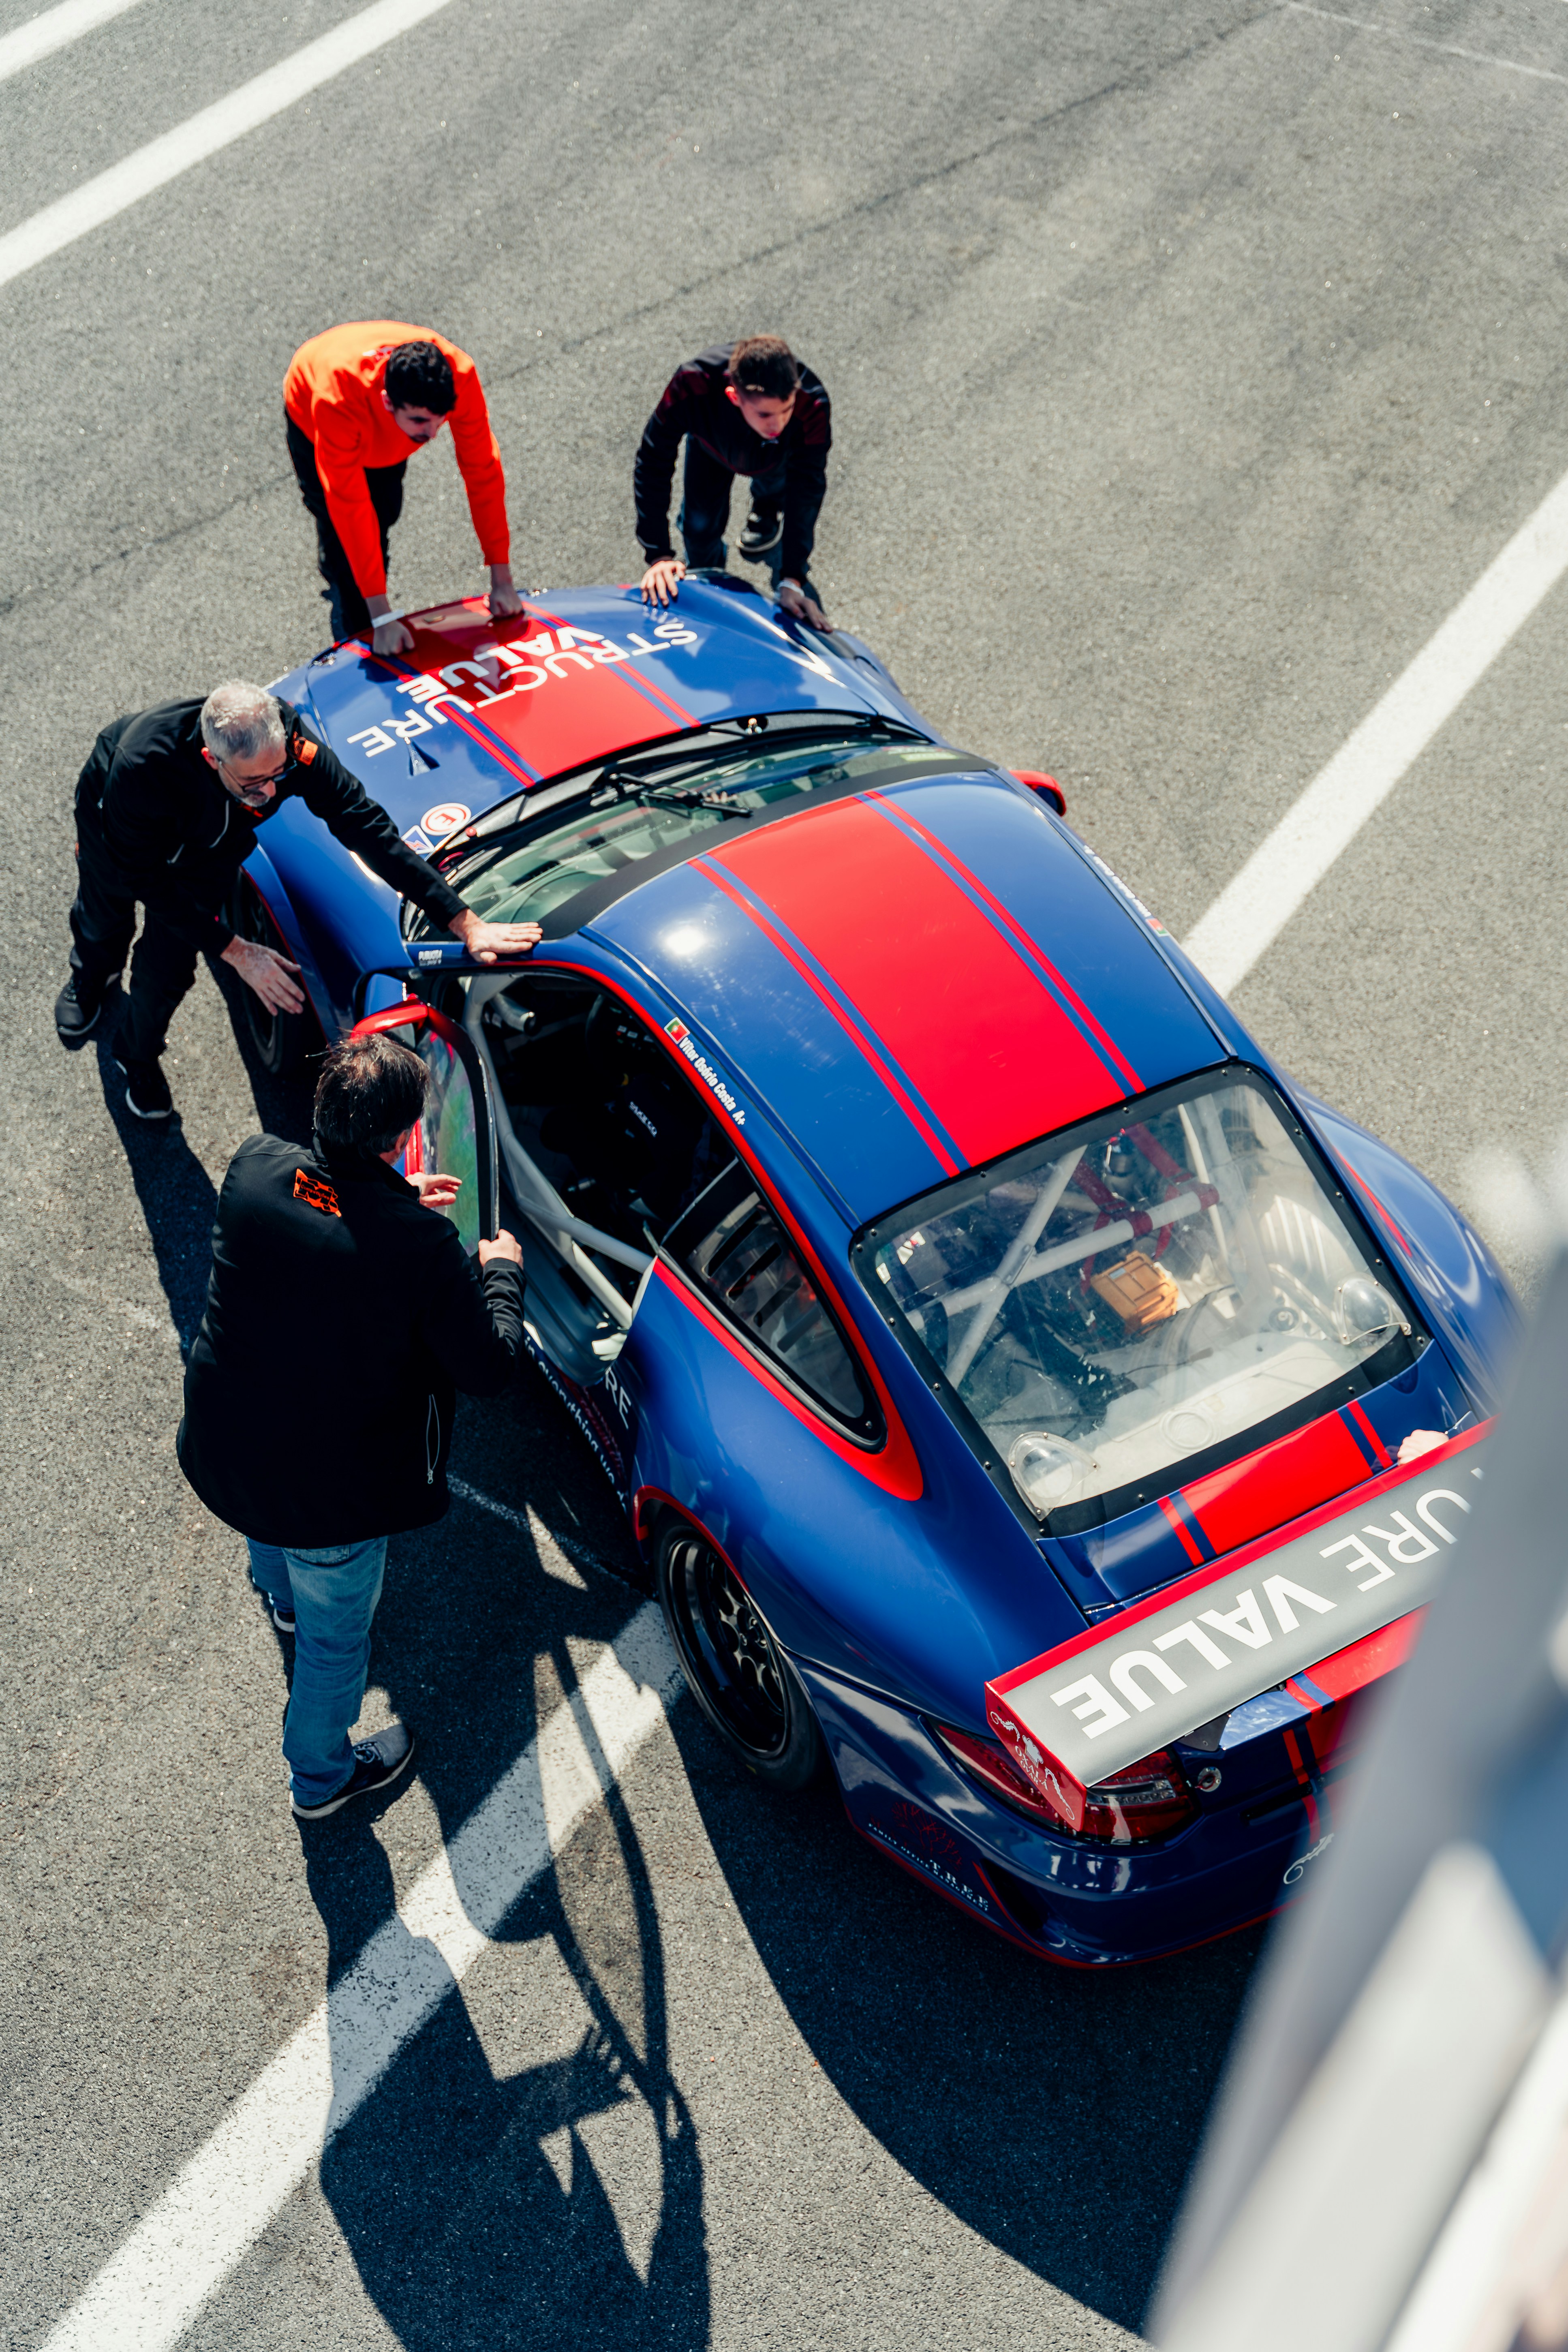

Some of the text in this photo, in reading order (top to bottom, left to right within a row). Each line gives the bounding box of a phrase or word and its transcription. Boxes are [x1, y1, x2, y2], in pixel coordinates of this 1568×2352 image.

[347, 623, 697, 758] STRUCTURE
[396, 627, 605, 704] VALUE
[714, 1083, 736, 1111] Costa
[732, 1110, 745, 1125] A+
[1050, 1475, 1481, 1739] URE VALUE
